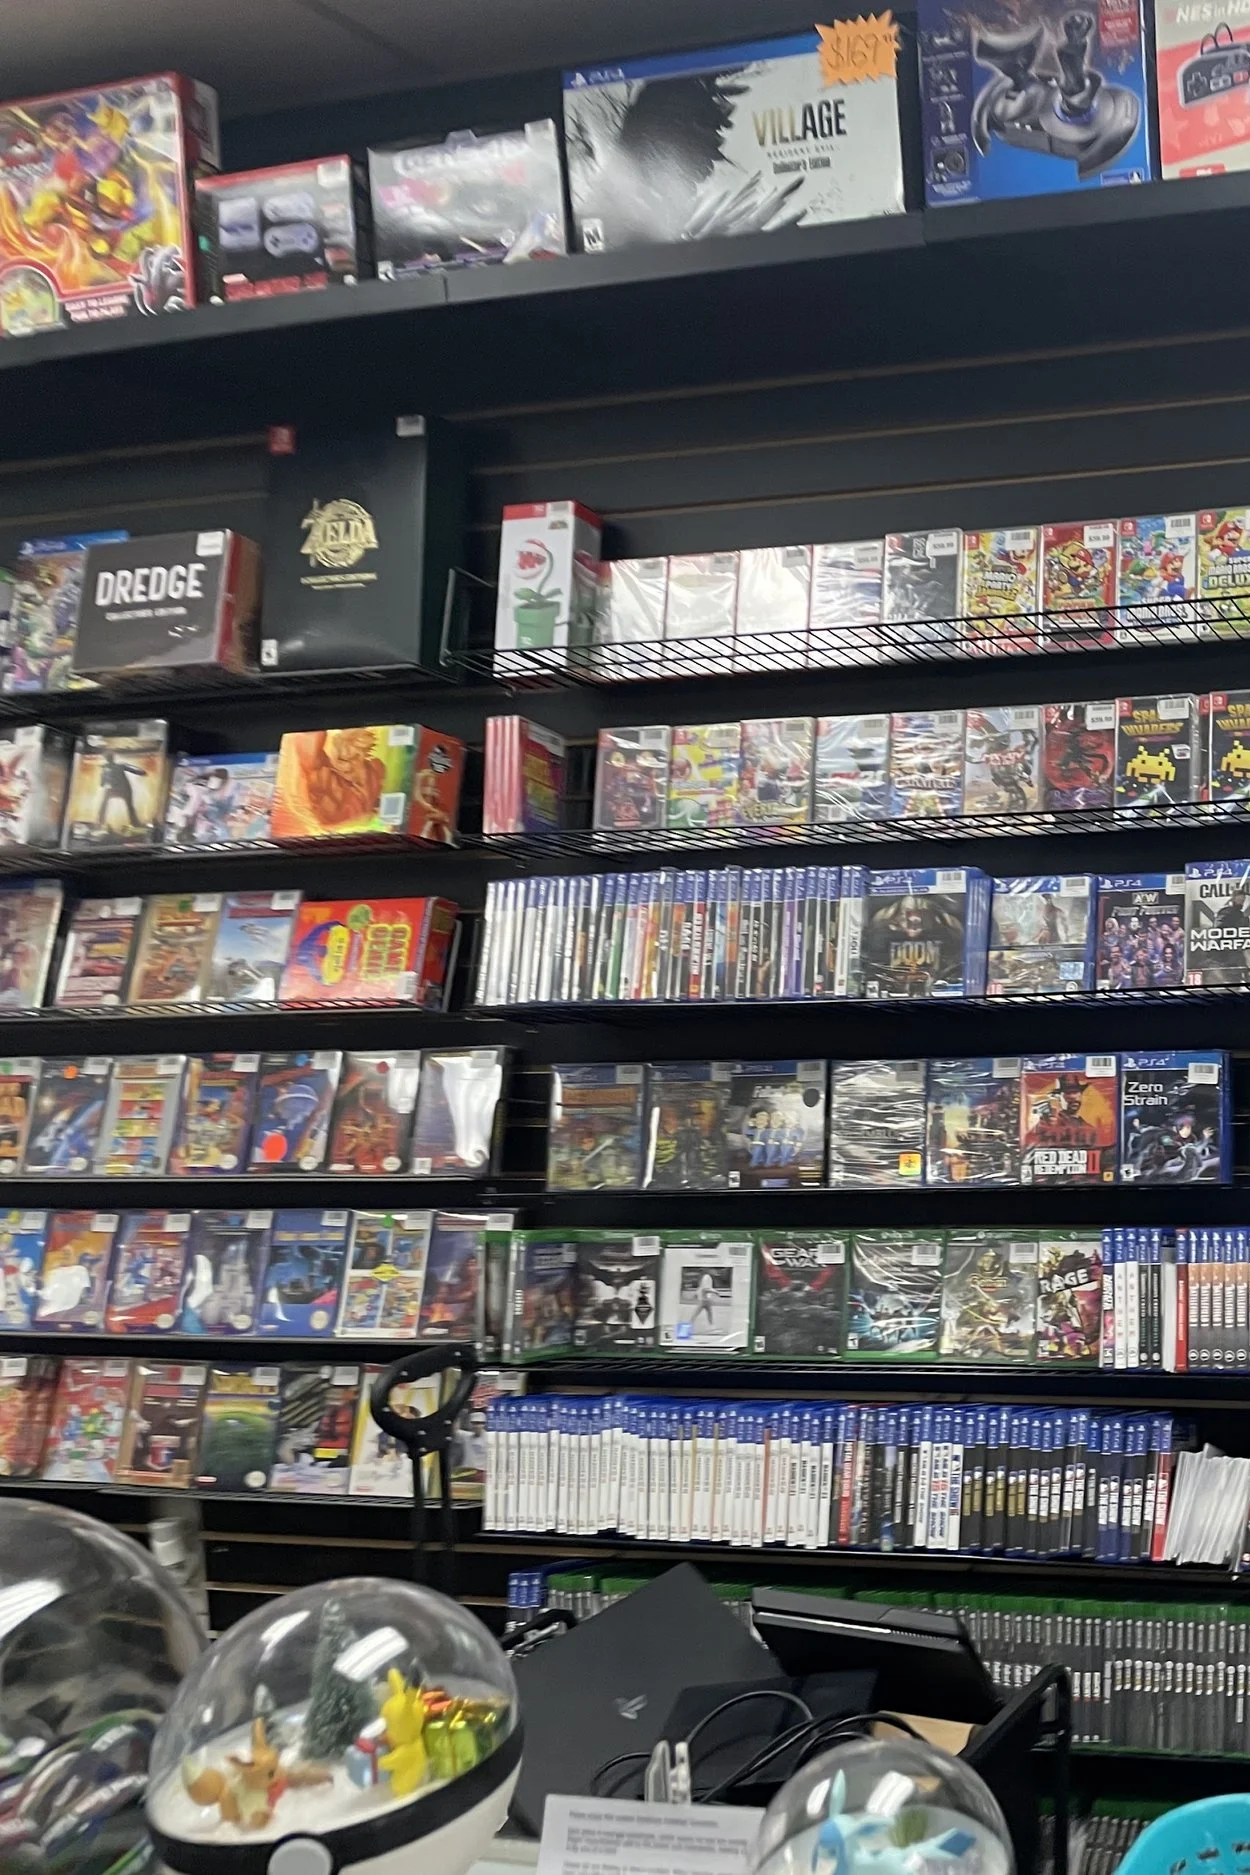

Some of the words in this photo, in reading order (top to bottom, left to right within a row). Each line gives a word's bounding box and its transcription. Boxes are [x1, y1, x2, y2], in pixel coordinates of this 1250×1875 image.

[752, 98, 847, 147] VILLAGE
[95, 563, 207, 606] DREDGE
[1120, 721, 1184, 737] INVADERS
[1115, 878, 1142, 888] PS4
[1200, 882, 1224, 899] CALL
[1189, 972, 1201, 985] 18
[1128, 1081, 1164, 1094] Zero
[1124, 1094, 1168, 1107] Strain
[1034, 1151, 1056, 1165] RED
[1058, 1149, 1087, 1165] DEAD
[1041, 1269, 1087, 1293] RAGE
